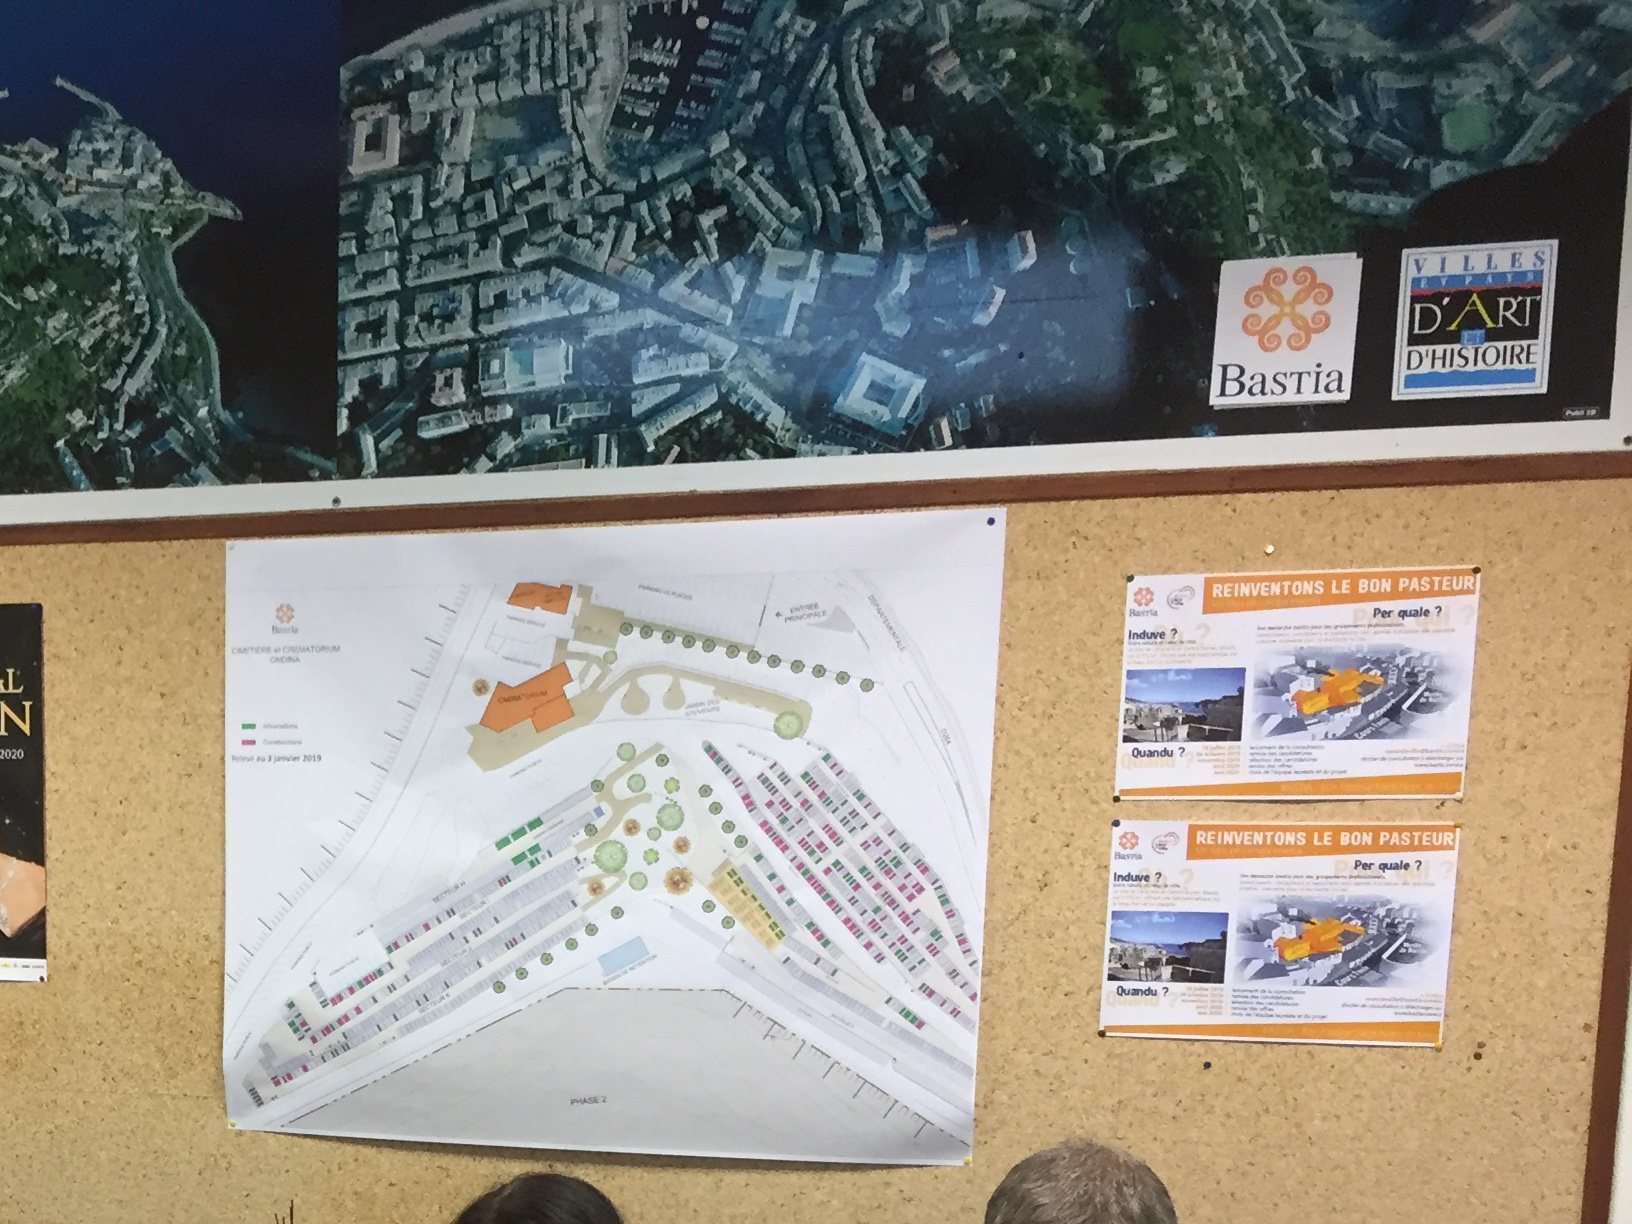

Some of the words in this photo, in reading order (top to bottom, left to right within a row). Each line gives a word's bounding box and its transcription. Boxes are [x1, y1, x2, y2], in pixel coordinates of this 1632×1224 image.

[1413, 250, 1545, 275] VILLES
[1413, 292, 1541, 334] D'ART
[1406, 343, 1538, 371] D'HISTOIRE
[1211, 580, 1325, 598] REINVENTONS
[1330, 578, 1352, 594] LE
[1358, 577, 1393, 594] BON
[1398, 575, 1475, 593] PASTEUR
[1372, 607, 1394, 619] Per
[1397, 606, 1431, 620] quale
[1434, 605, 1443, 617] ?
[1127, 628, 1166, 640] Induve
[1170, 627, 1179, 640] ?
[1131, 747, 1174, 759] Quandu
[1177, 746, 1186, 758] ?
[1195, 831, 1307, 847] REINVENTONS
[1313, 831, 1333, 846] LE
[1339, 831, 1373, 847] BON
[1379, 831, 1454, 846] PASTEUR
[1354, 860, 1374, 871] Per
[1378, 860, 1410, 873] quale
[1414, 860, 1422, 871] ?
[1113, 872, 1150, 883] Induve
[1154, 871, 1162, 883] ?
[1116, 986, 1158, 997] Quandu
[1161, 986, 1169, 997] ?
[570, 1096, 599, 1105] PHASE
[601, 1095, 607, 1103] 2
